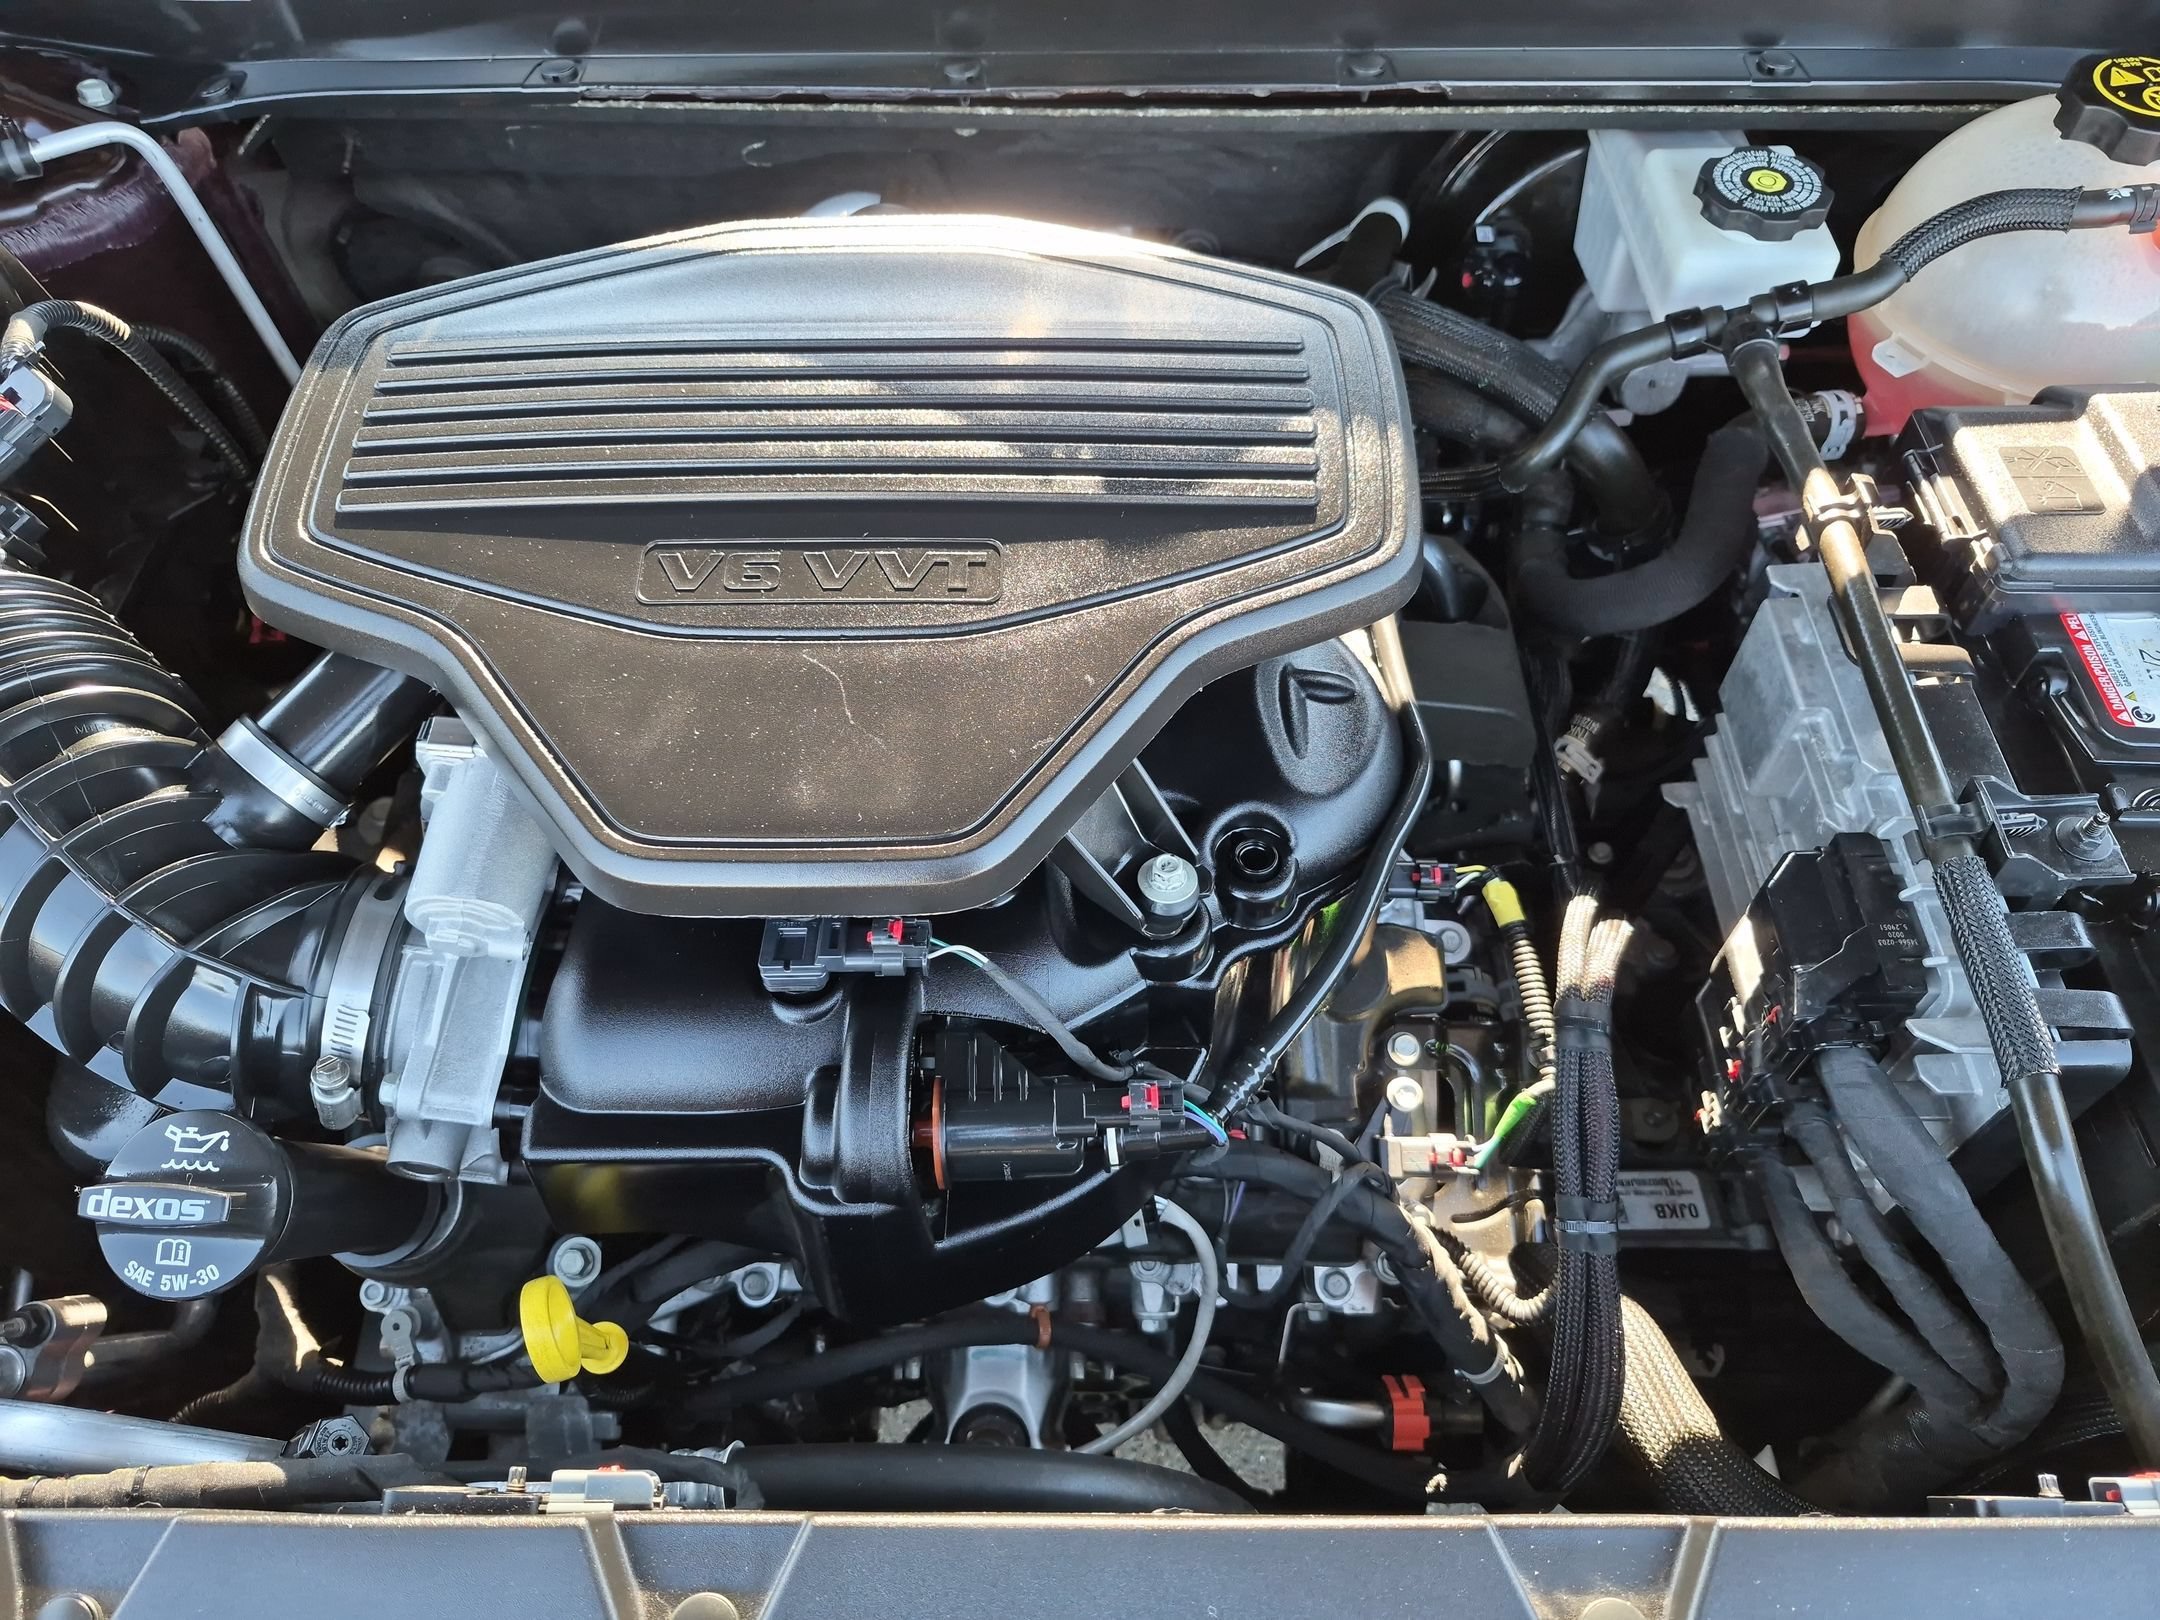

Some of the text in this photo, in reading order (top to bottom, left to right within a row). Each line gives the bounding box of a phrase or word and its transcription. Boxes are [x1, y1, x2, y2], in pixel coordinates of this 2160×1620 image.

[657, 551, 988, 592] V6 VVT
[2081, 644, 2125, 711] DANGER/POISON
[86, 1188, 206, 1222] dexos
[124, 1260, 220, 1292] SAE 5W-30
